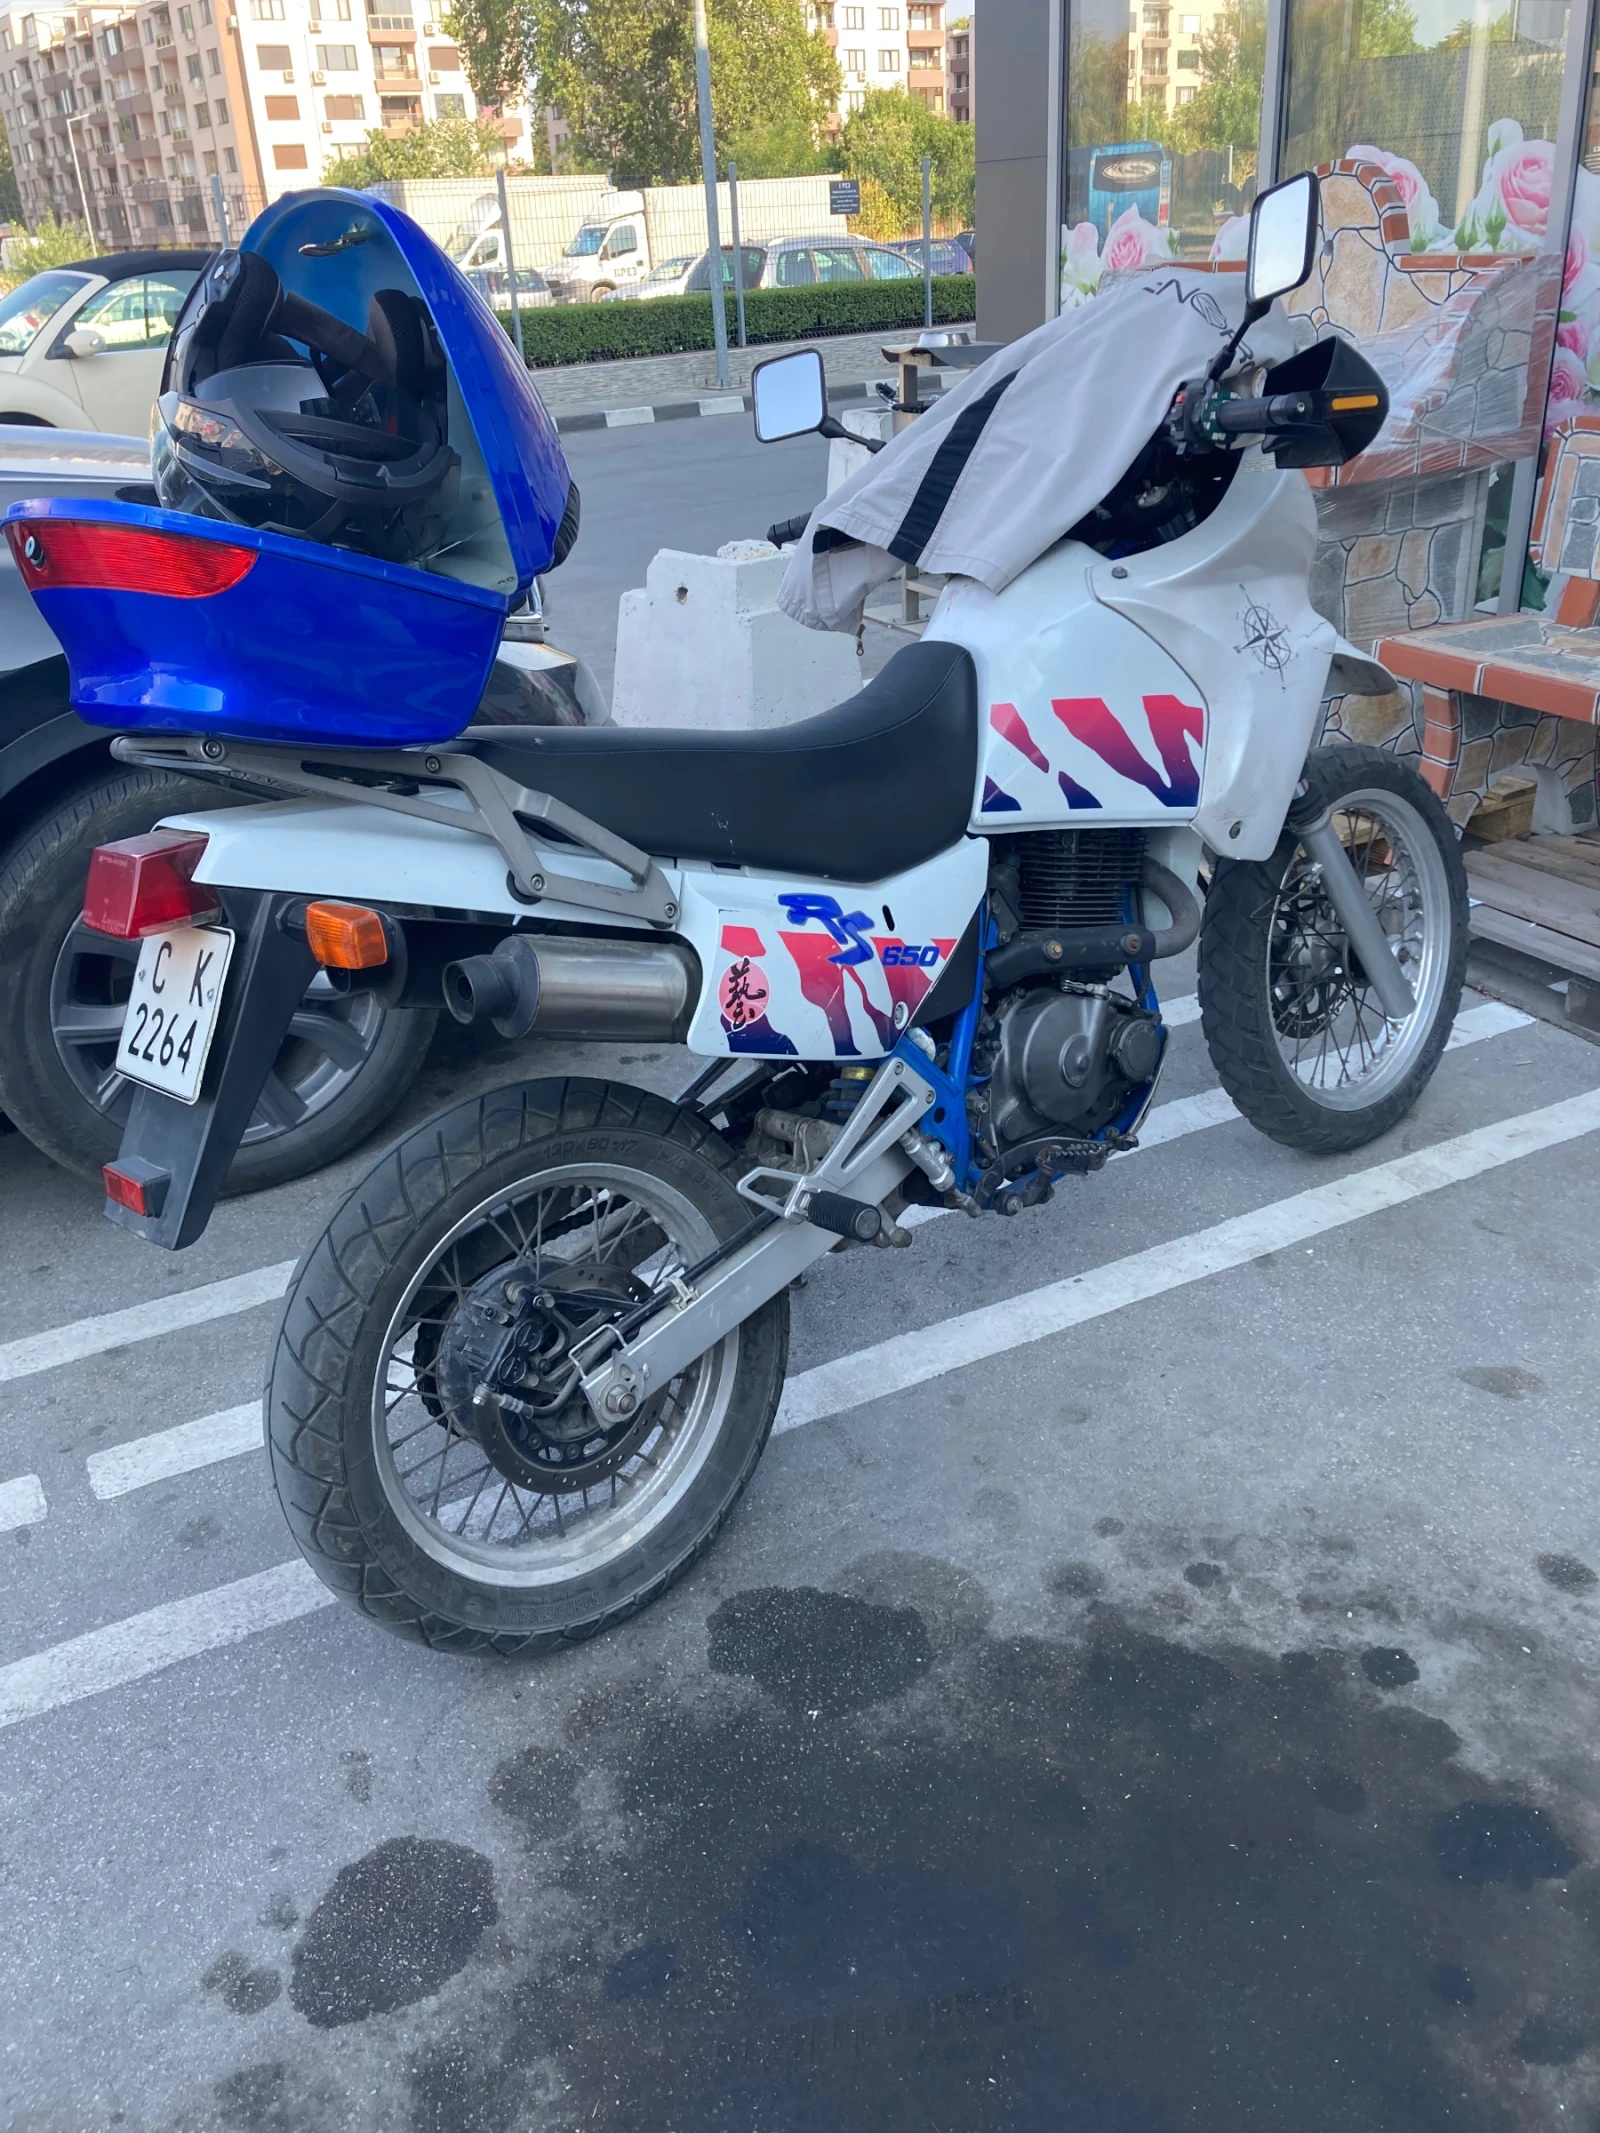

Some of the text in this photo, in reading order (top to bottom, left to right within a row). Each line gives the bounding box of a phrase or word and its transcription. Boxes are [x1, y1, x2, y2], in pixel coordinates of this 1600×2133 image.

[152, 939, 214, 1008] C K
[881, 944, 942, 968] 650
[127, 1002, 199, 1074] 2264
[502, 1591, 605, 1625] HEIDENAU
